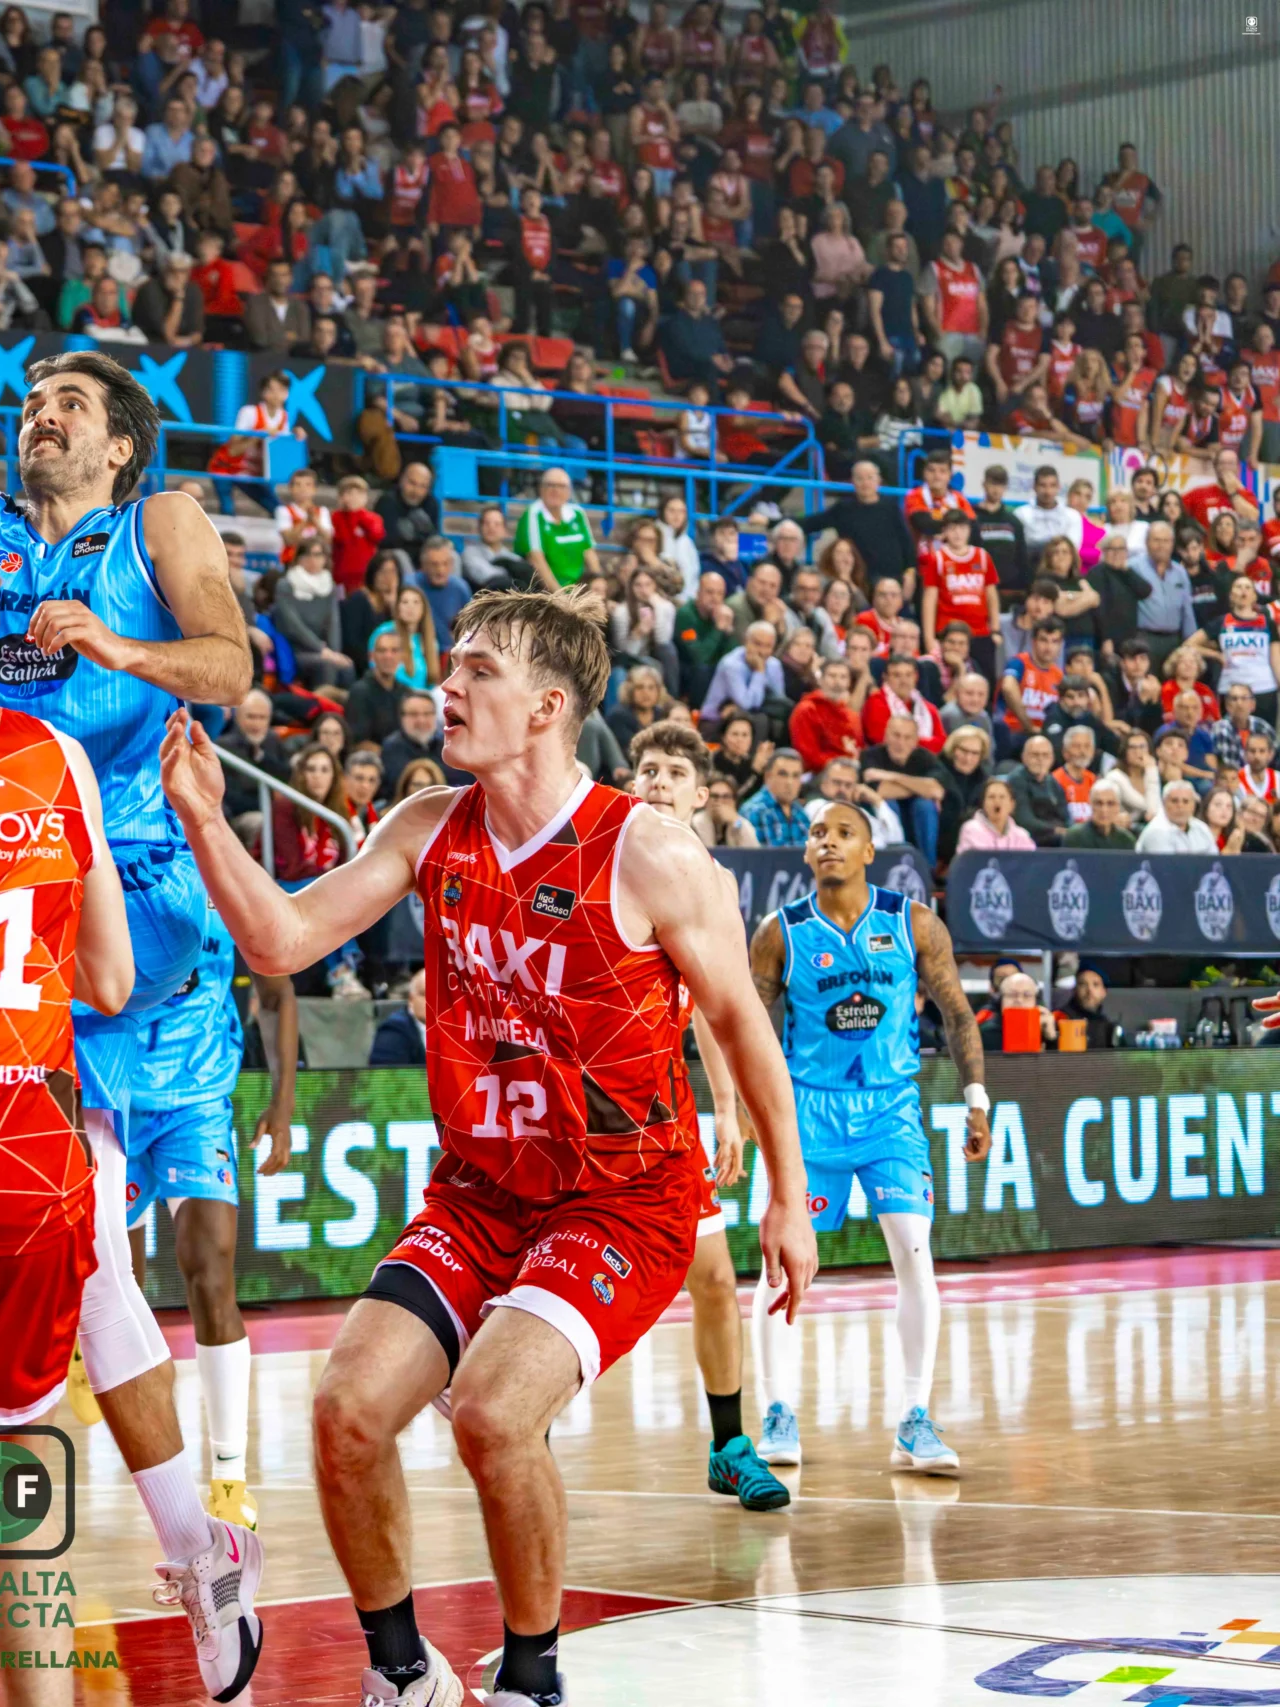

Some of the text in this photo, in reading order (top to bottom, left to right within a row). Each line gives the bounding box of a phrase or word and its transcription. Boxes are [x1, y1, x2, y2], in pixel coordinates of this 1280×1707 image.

[0, 662, 58, 681] Galicia
[538, 892, 555, 904] liga
[974, 891, 1011, 910] BAXI
[1051, 891, 1087, 910] BAXI
[1125, 893, 1162, 911] BAXI
[1198, 893, 1233, 911] BAXI
[536, 901, 570, 917] endesa
[440, 915, 568, 996] BAXI
[835, 1003, 880, 1018] Estrella
[835, 1016, 878, 1030] Galicia
[844, 1052, 867, 1088] 4
[471, 1074, 552, 1139] 12
[1064, 1091, 1280, 1208] CUEN
[605, 1252, 622, 1272] acb
